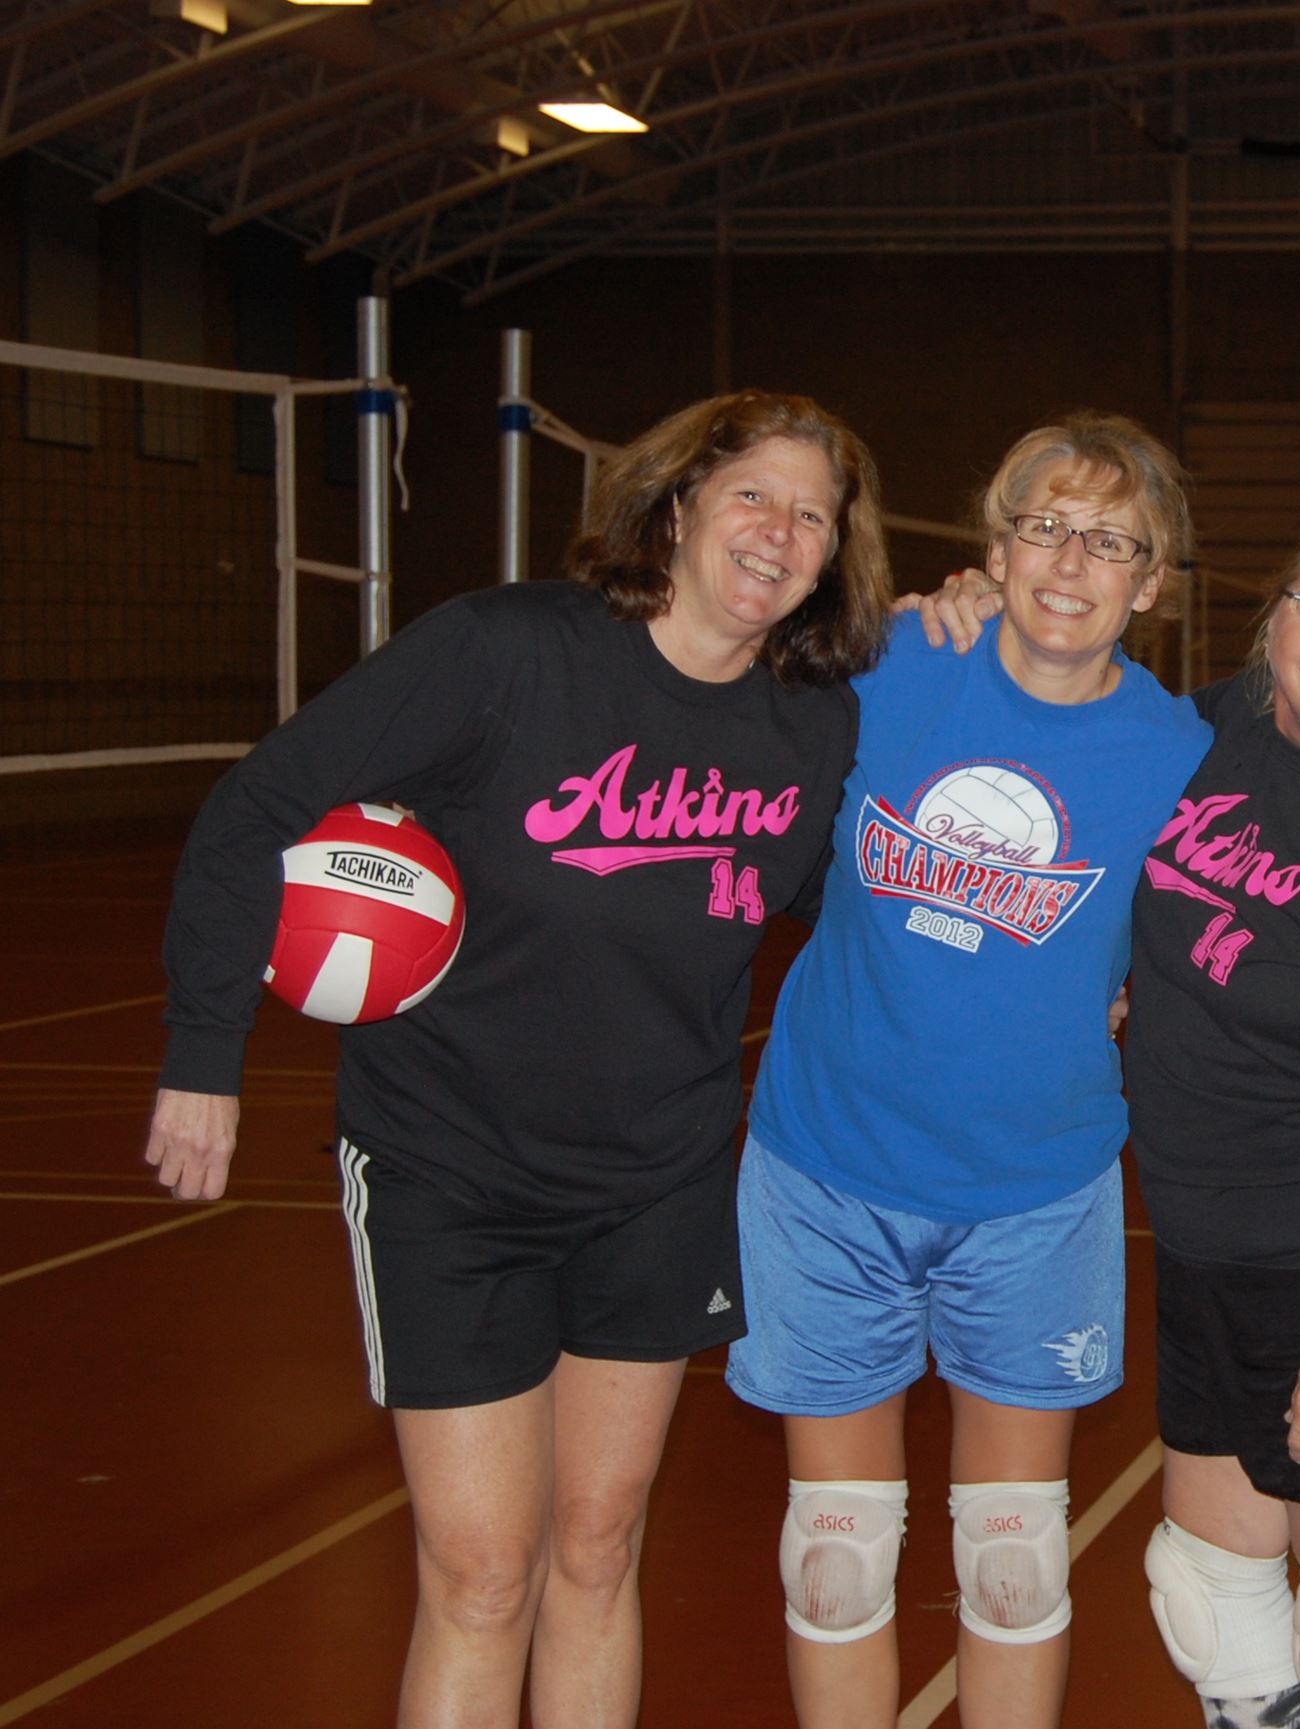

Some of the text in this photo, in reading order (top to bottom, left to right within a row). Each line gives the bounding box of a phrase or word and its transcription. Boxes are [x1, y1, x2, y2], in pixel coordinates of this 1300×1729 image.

[524, 743, 800, 843] Atkins
[325, 850, 420, 891] TACHIKARA
[925, 812, 1042, 866] Volleyball
[707, 857, 765, 926] 14
[862, 818, 1081, 935] CHAMPIONS
[905, 905, 984, 954] 2012
[1190, 910, 1255, 987] 14
